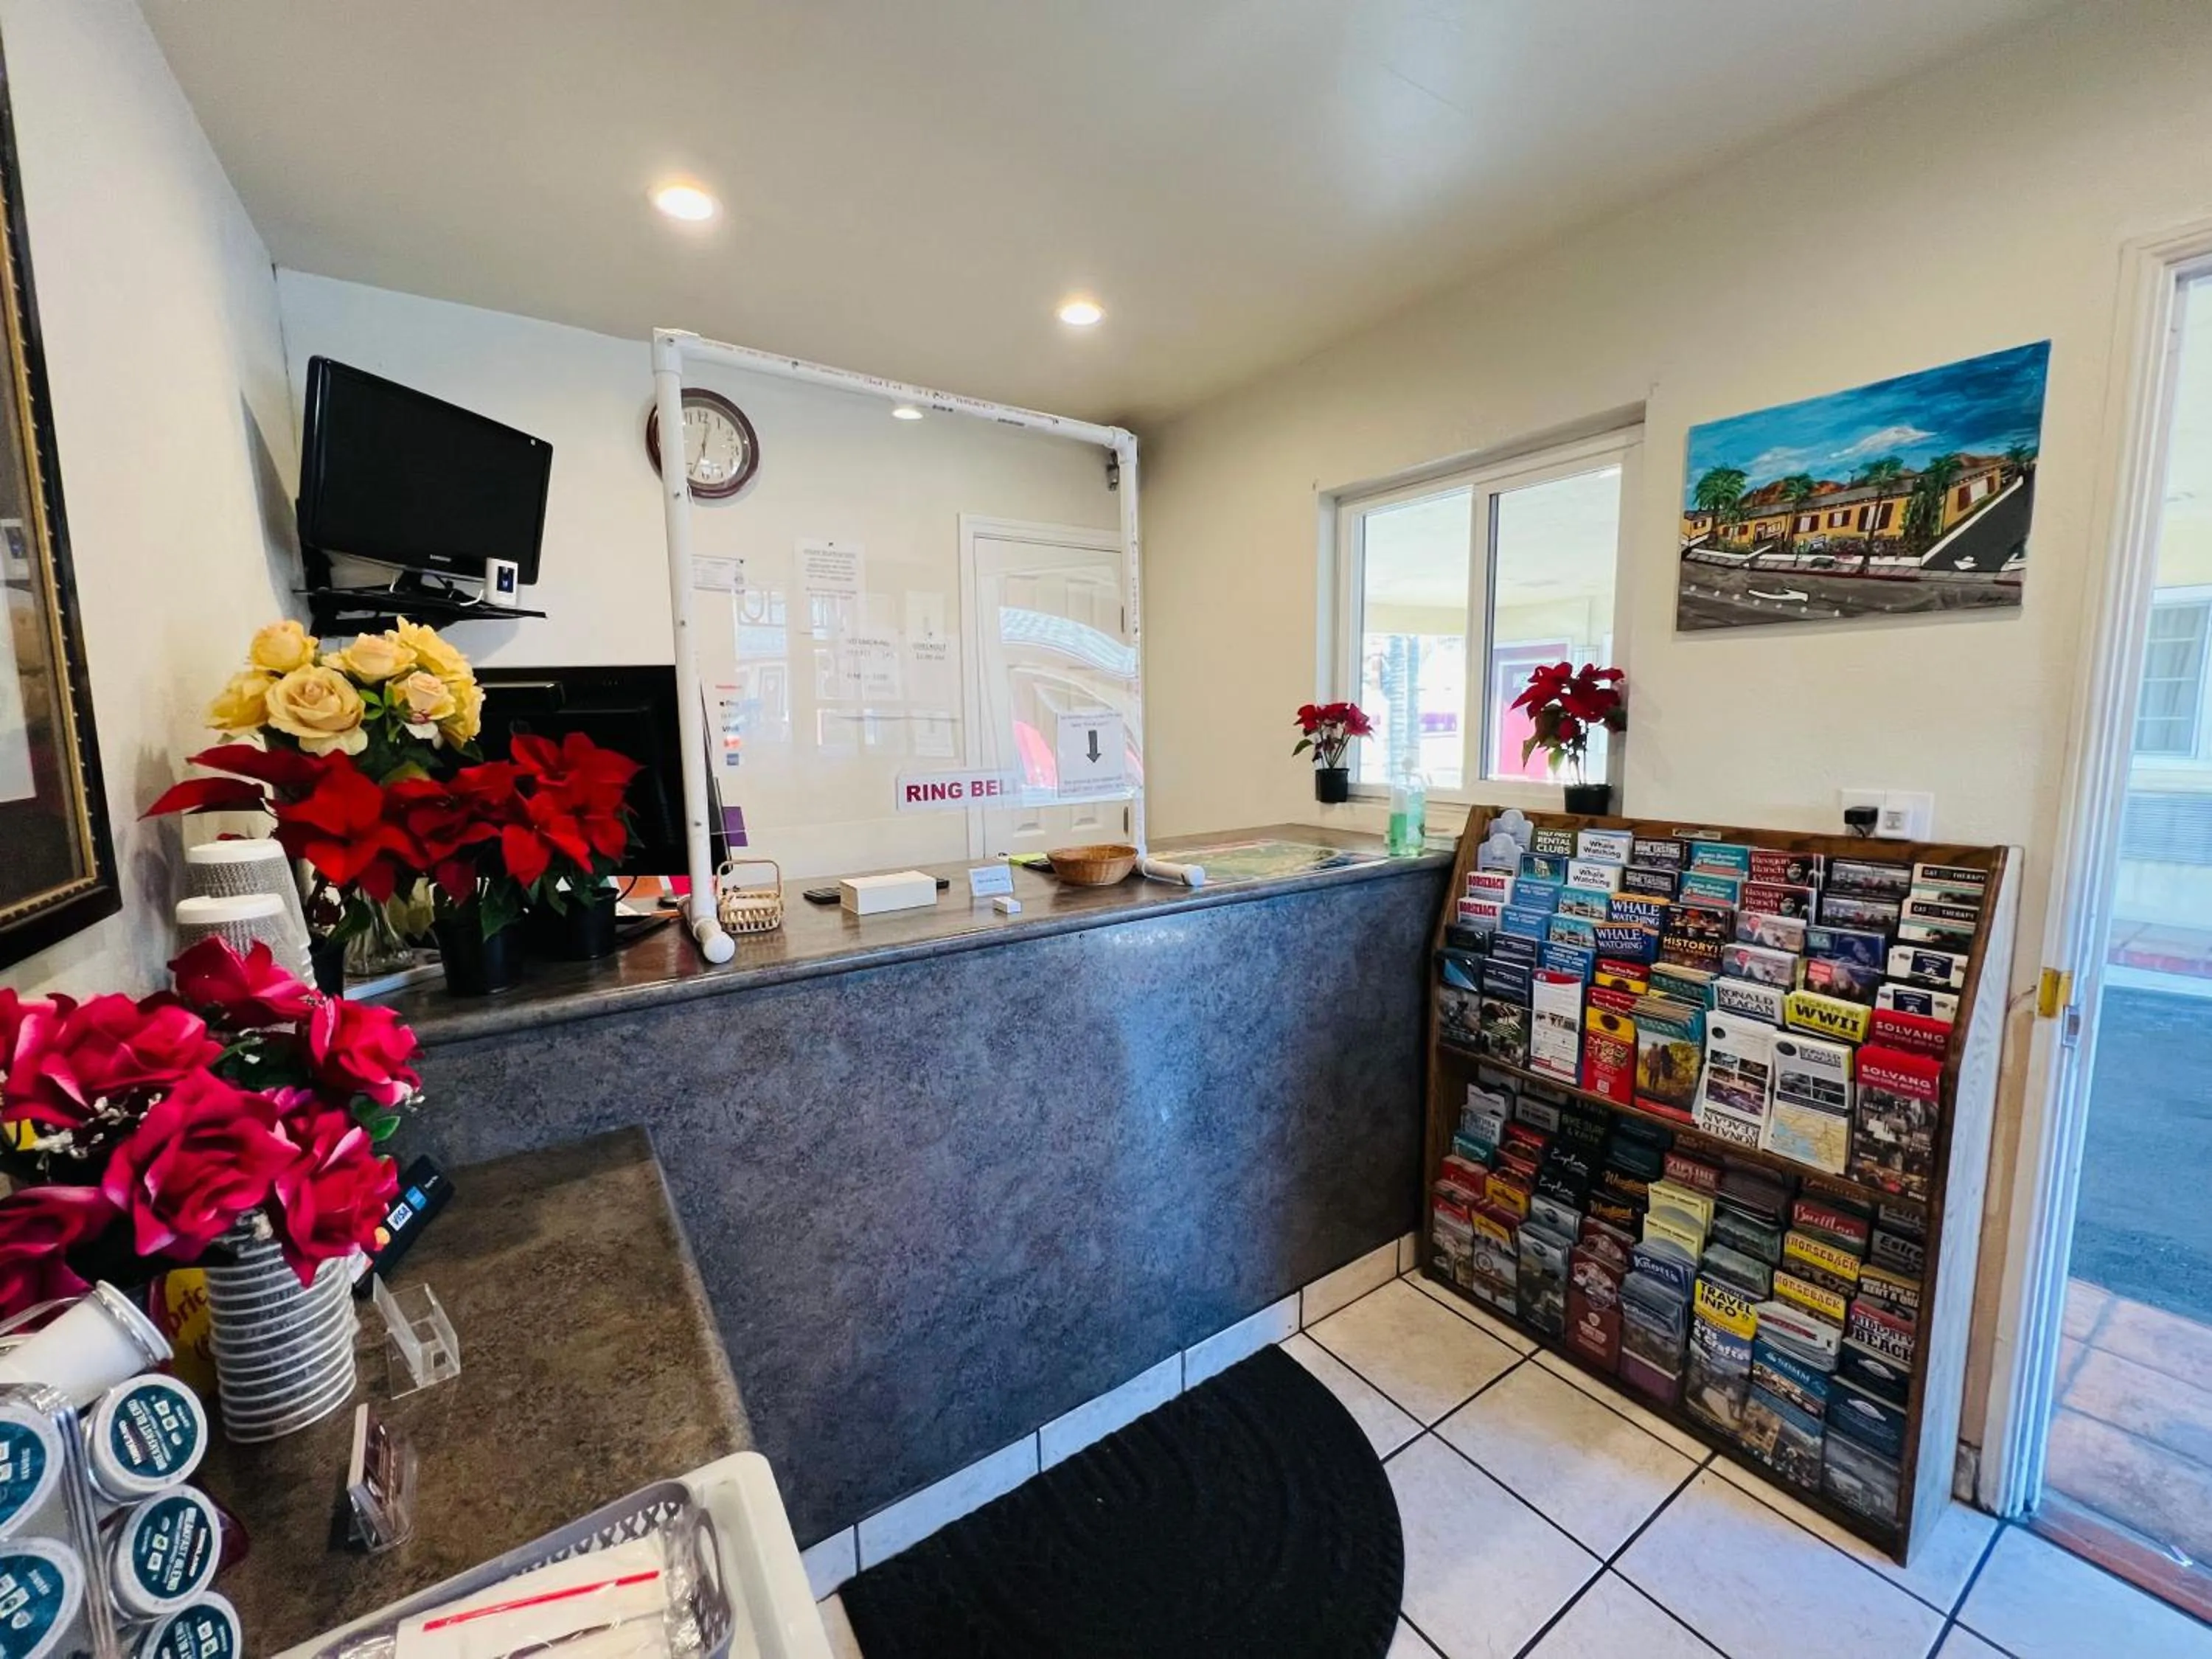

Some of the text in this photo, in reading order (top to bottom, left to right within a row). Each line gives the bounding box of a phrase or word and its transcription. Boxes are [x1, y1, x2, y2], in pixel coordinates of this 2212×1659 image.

[906, 782, 962, 802] RING
[1537, 837, 1571, 846] RENTAL
[1537, 844, 1571, 855] CLUBS
[1583, 846, 1621, 859] Watching
[1751, 855, 1791, 866] Reagan
[1579, 869, 1605, 878] Whale
[1752, 865, 1785, 874] Ranch
[1573, 875, 1611, 888] Watching
[1745, 887, 1784, 899] Reagan
[1611, 900, 1660, 917] WHALE
[1745, 897, 1778, 908] Ranch
[1611, 913, 1660, 927] WATCHING
[1596, 928, 1642, 941] WHALE
[1598, 940, 1643, 951] WATCHING
[1719, 987, 1774, 1006] RONALD
[1720, 997, 1775, 1015] REAGAN
[1795, 1004, 1860, 1032] WWII
[1875, 1020, 1945, 1044] SOLVANG
[1862, 1064, 1932, 1089] SOLVANG
[390, 1204, 411, 1229] VISA
[1701, 1281, 1753, 1315] TRAVEL
[1701, 1293, 1737, 1318] INFO
[140, 1423, 169, 1471] BREAKFAST
